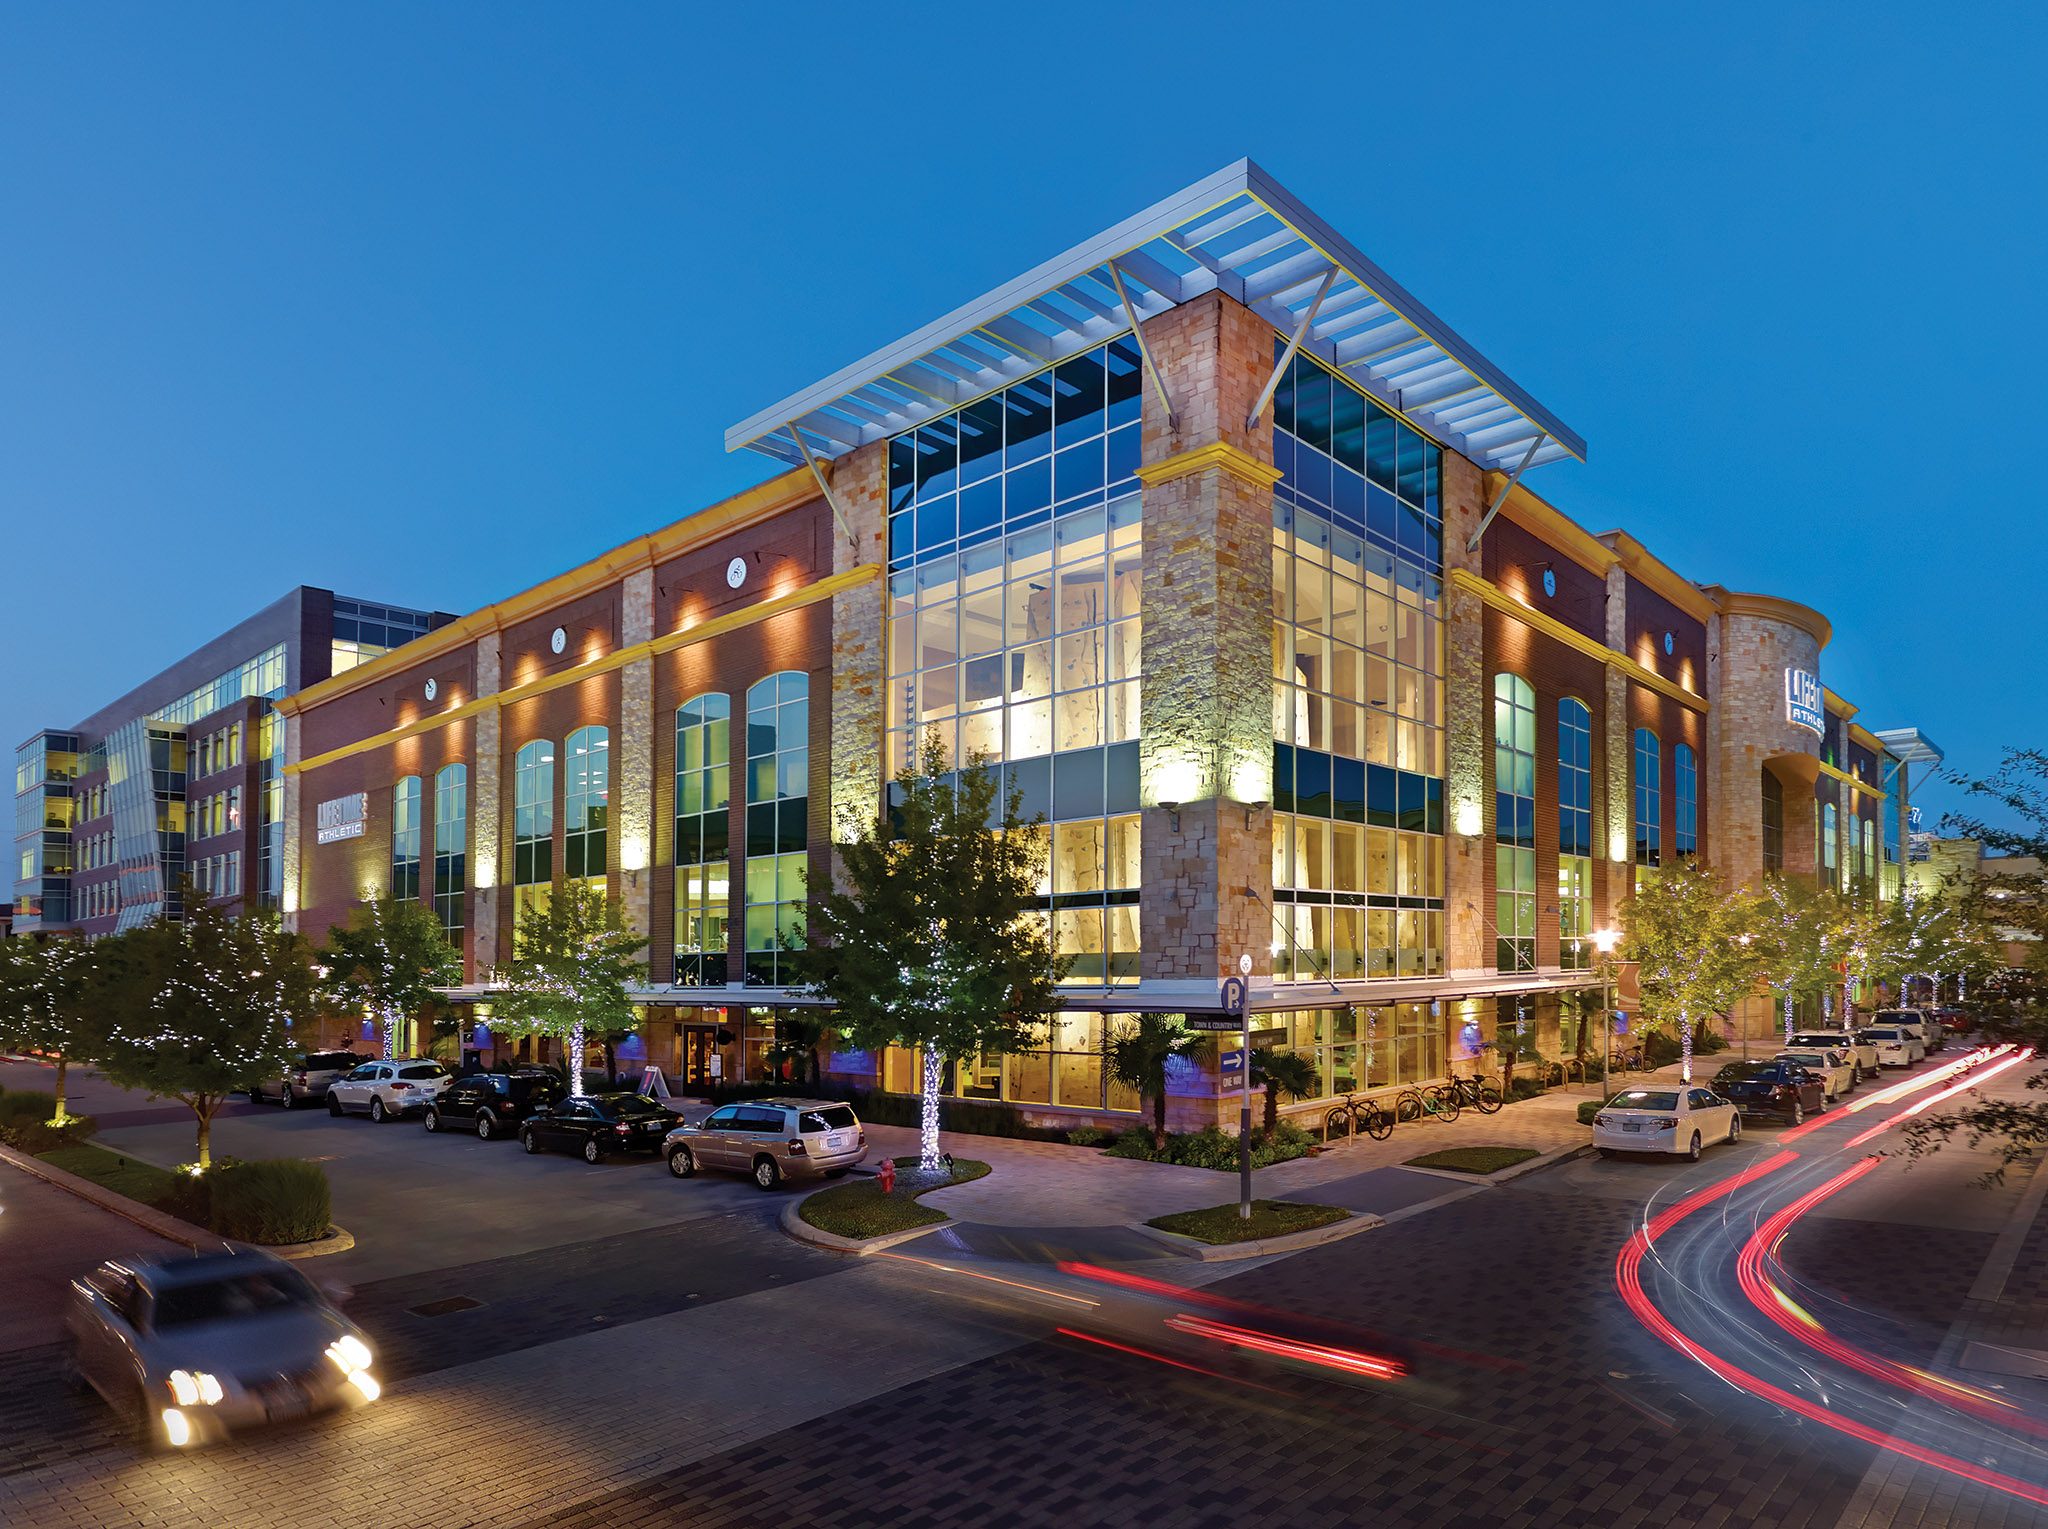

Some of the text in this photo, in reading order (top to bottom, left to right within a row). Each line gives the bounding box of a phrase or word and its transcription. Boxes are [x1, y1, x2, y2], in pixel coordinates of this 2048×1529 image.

[318, 824, 362, 841] ATHLETIC
[1227, 982, 1240, 1009] P
[1212, 1021, 1233, 1029] COUNTRY
[1222, 1075, 1242, 1088] ONE WAY
